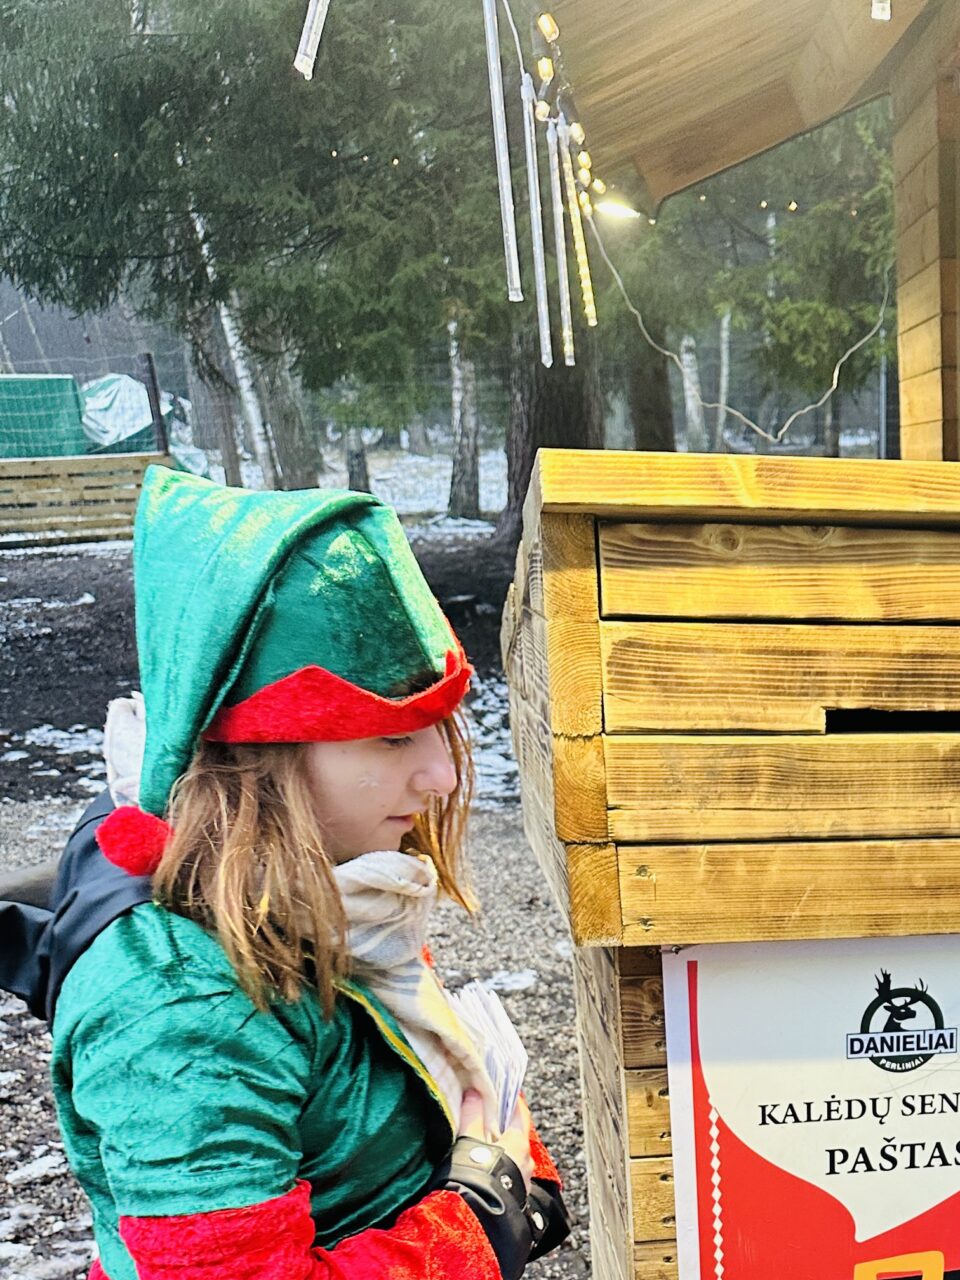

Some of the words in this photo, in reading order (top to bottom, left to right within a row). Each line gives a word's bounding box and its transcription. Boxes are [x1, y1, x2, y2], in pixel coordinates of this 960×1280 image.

[849, 1032, 955, 1055] DANIELIAI
[879, 1056, 925, 1071] PERLINIAI
[758, 1094, 893, 1126] KALĖDŲ
